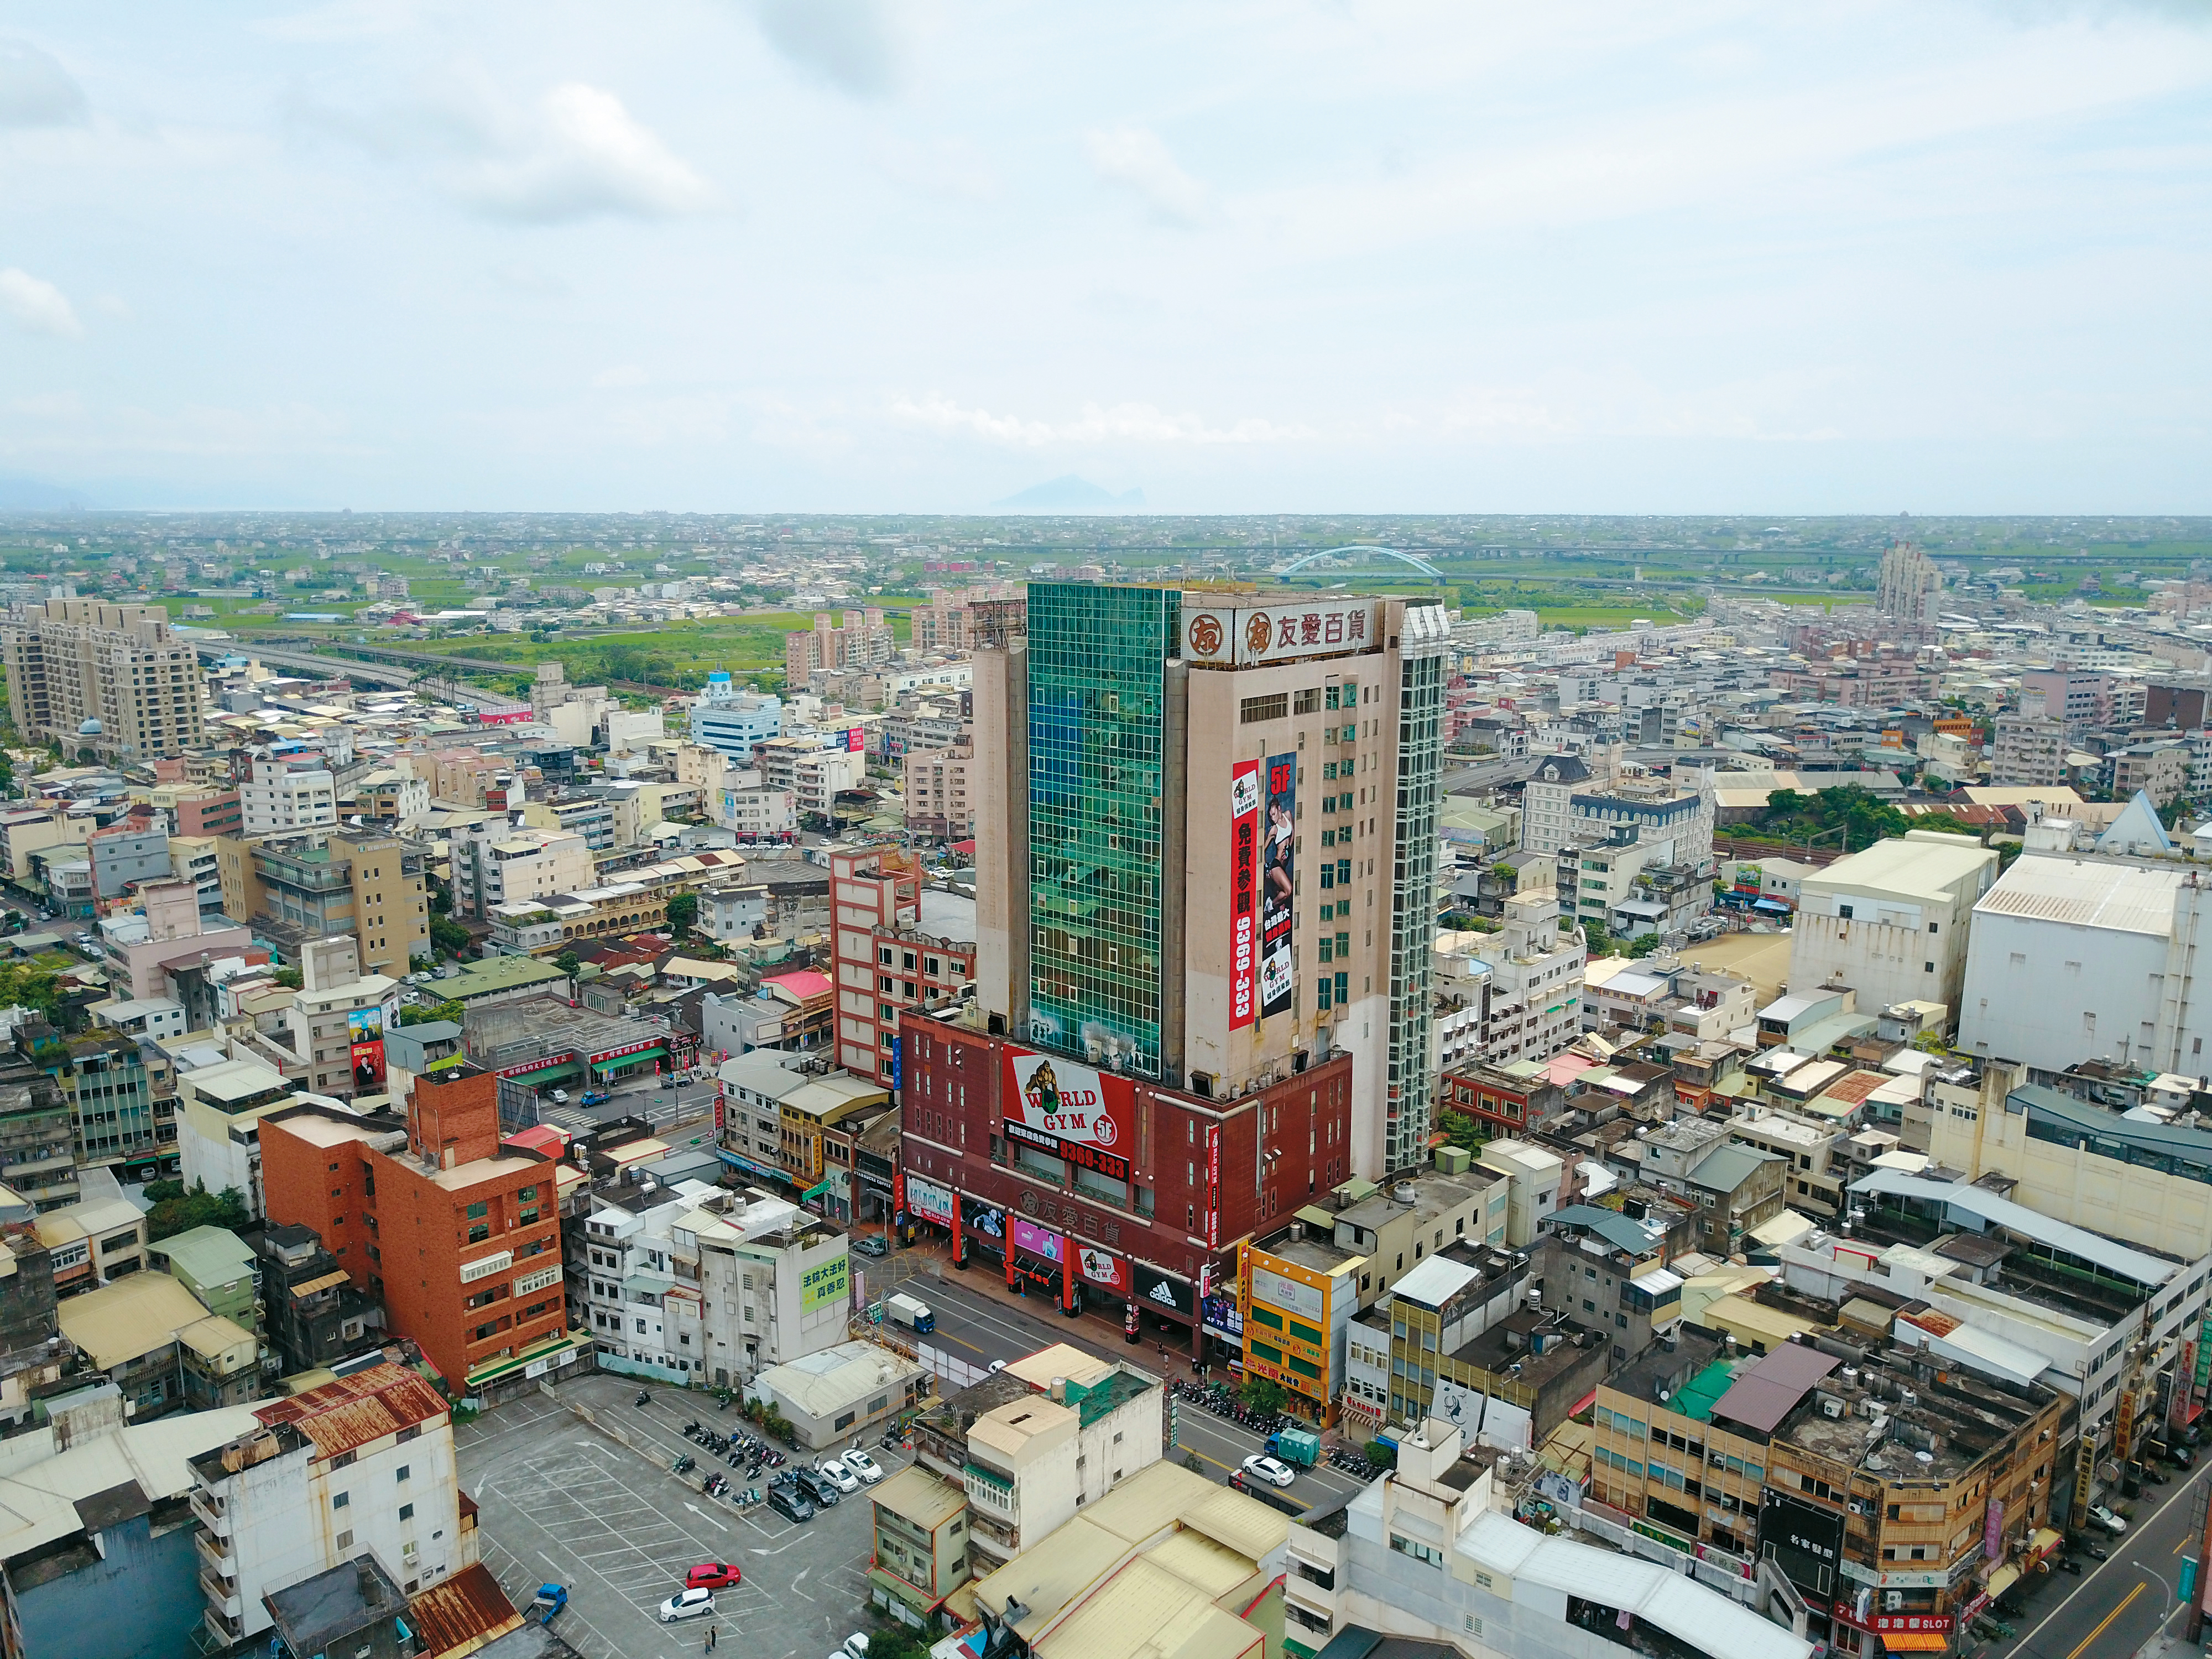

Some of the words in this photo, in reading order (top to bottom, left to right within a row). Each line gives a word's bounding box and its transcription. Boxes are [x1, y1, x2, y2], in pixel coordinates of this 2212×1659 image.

[1277, 609, 1366, 649] 友愛百貨
[1270, 764, 1291, 795] 5F
[1239, 794, 1252, 806] GYM
[1264, 908, 1290, 931] 台灣最大
[1235, 916, 1250, 1018] 9369-333
[1269, 973, 1285, 989] GYM
[1044, 1113, 1087, 1130] GYM
[1097, 1119, 1112, 1139] 5F
[1060, 1140, 1124, 1178] 9369-333
[1041, 1198, 1121, 1246] 友愛百貨
[802, 1259, 846, 1289] 法輪大法好
[817, 1276, 846, 1300] 真善忍
[1149, 1290, 1177, 1307] adidas
[1922, 1619, 1950, 1629] SLOT
